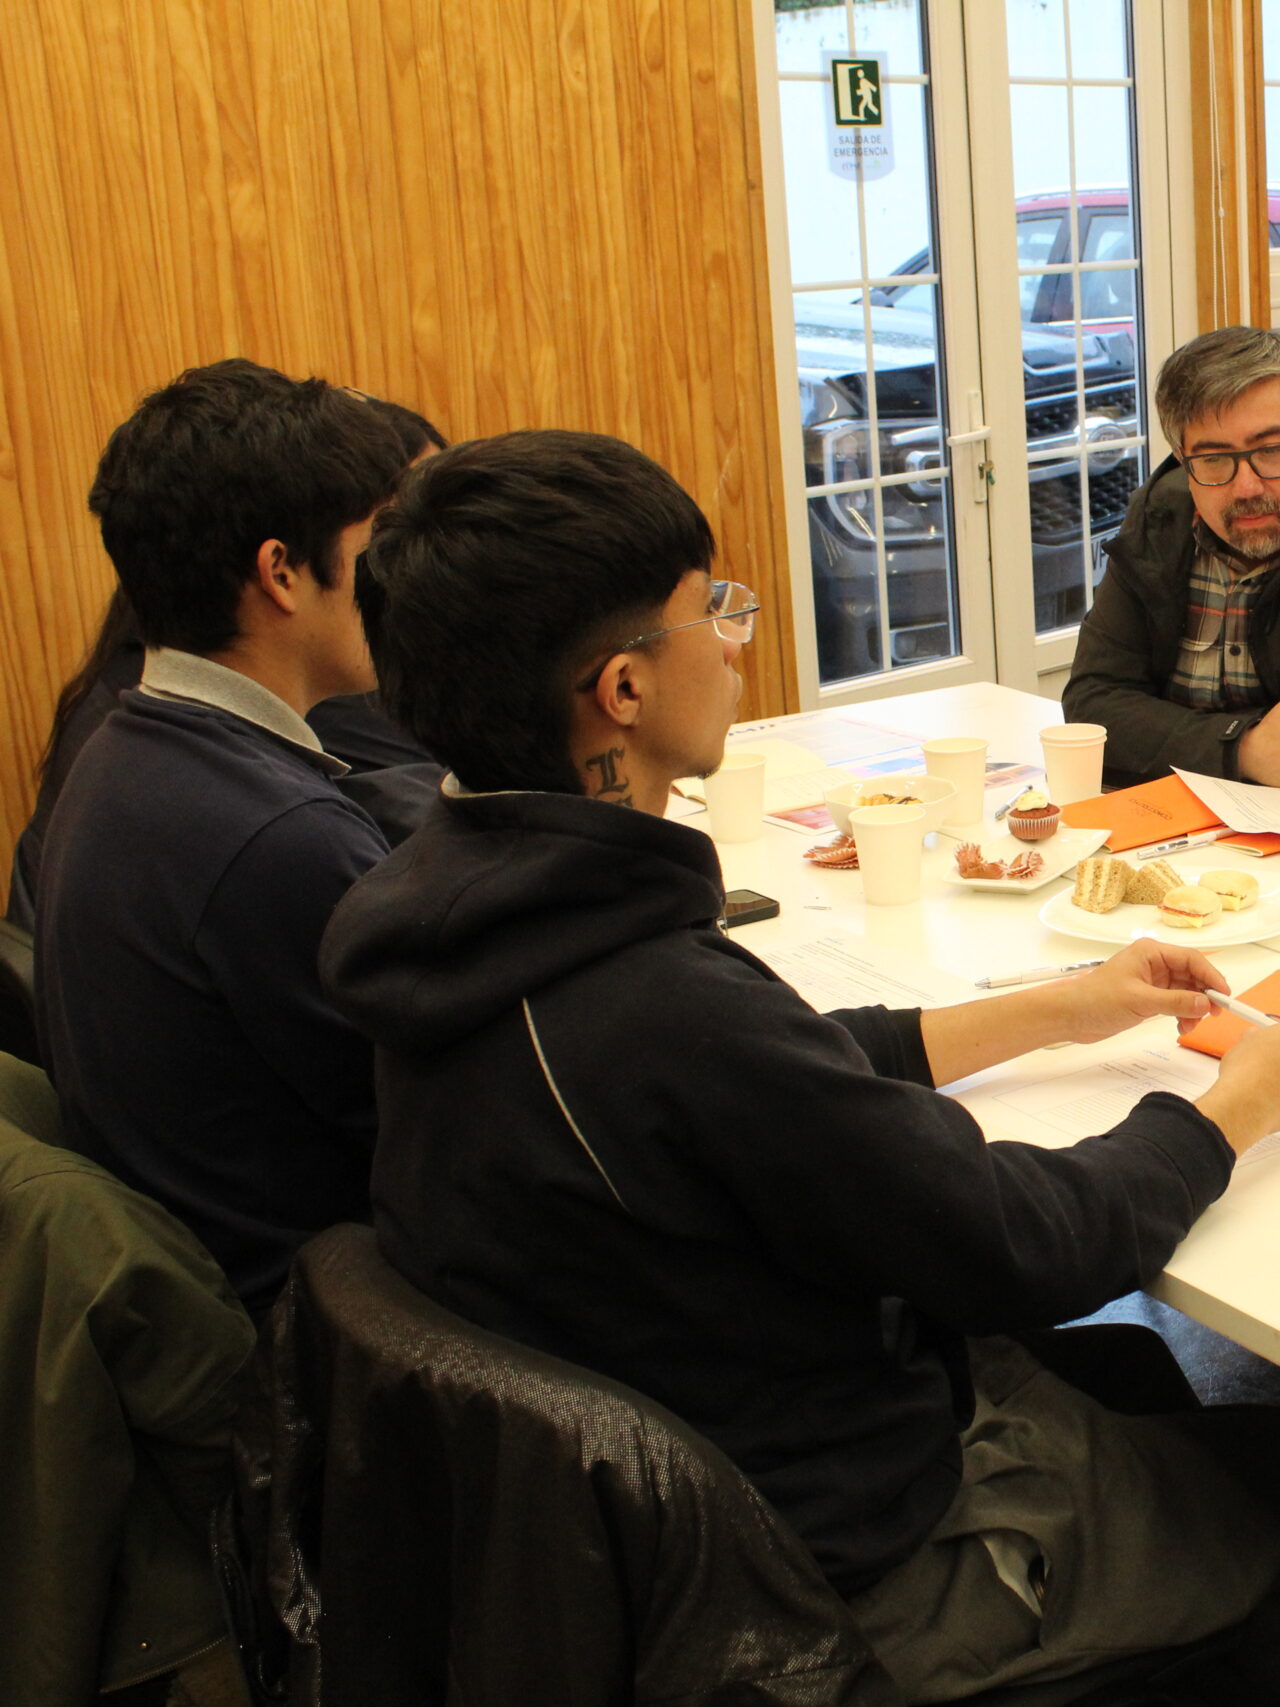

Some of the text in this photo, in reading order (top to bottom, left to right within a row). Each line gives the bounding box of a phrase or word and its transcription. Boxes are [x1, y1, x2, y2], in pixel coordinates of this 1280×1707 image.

[838, 135, 881, 145] SALIDA DE
[833, 147, 888, 157] EMERGENCIA
